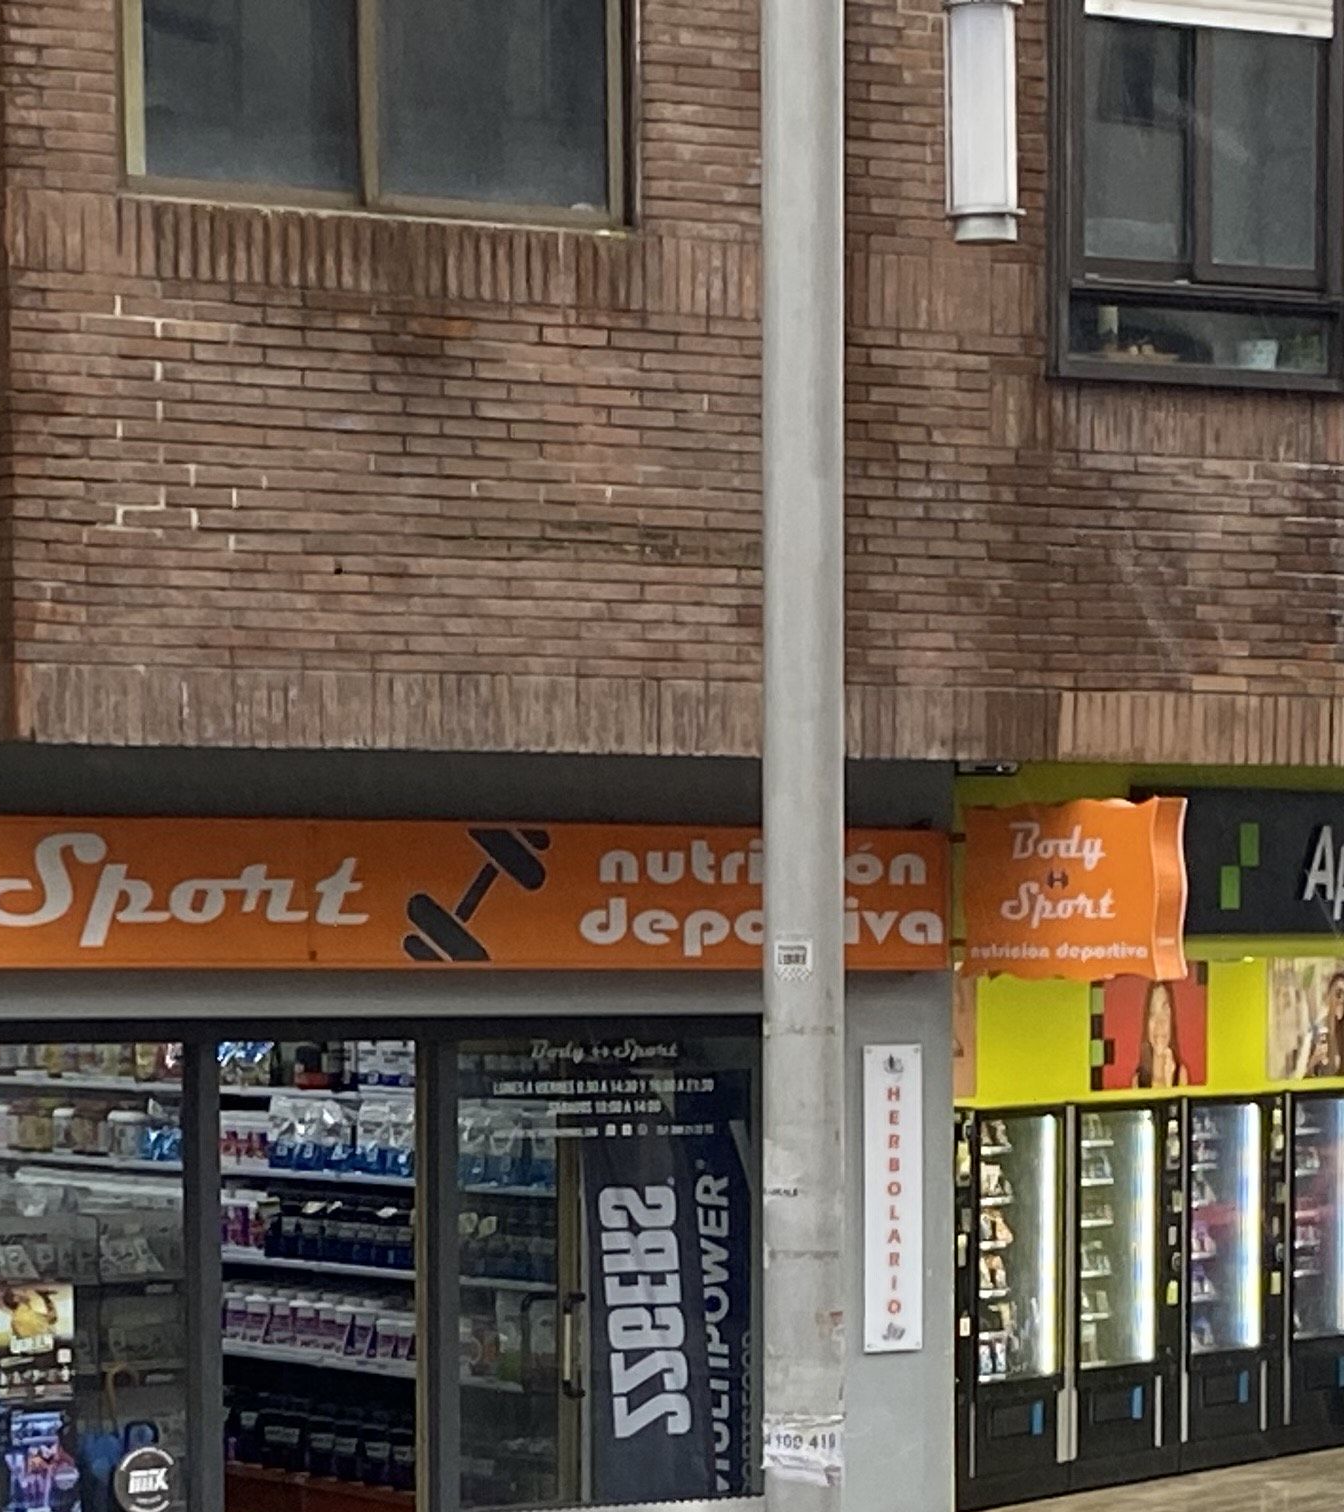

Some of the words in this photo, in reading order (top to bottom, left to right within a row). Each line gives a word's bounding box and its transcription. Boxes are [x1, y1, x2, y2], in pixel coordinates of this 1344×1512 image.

[598, 839, 928, 886] nutrión
[1008, 821, 1106, 871] Body
[579, 896, 944, 957] depoiva
[1001, 880, 1117, 929] Sport
[1056, 942, 1148, 963] deportiva
[530, 1038, 584, 1064] Body
[613, 1038, 678, 1062] Sport
[887, 1086, 902, 1314] HERBOLARIO
